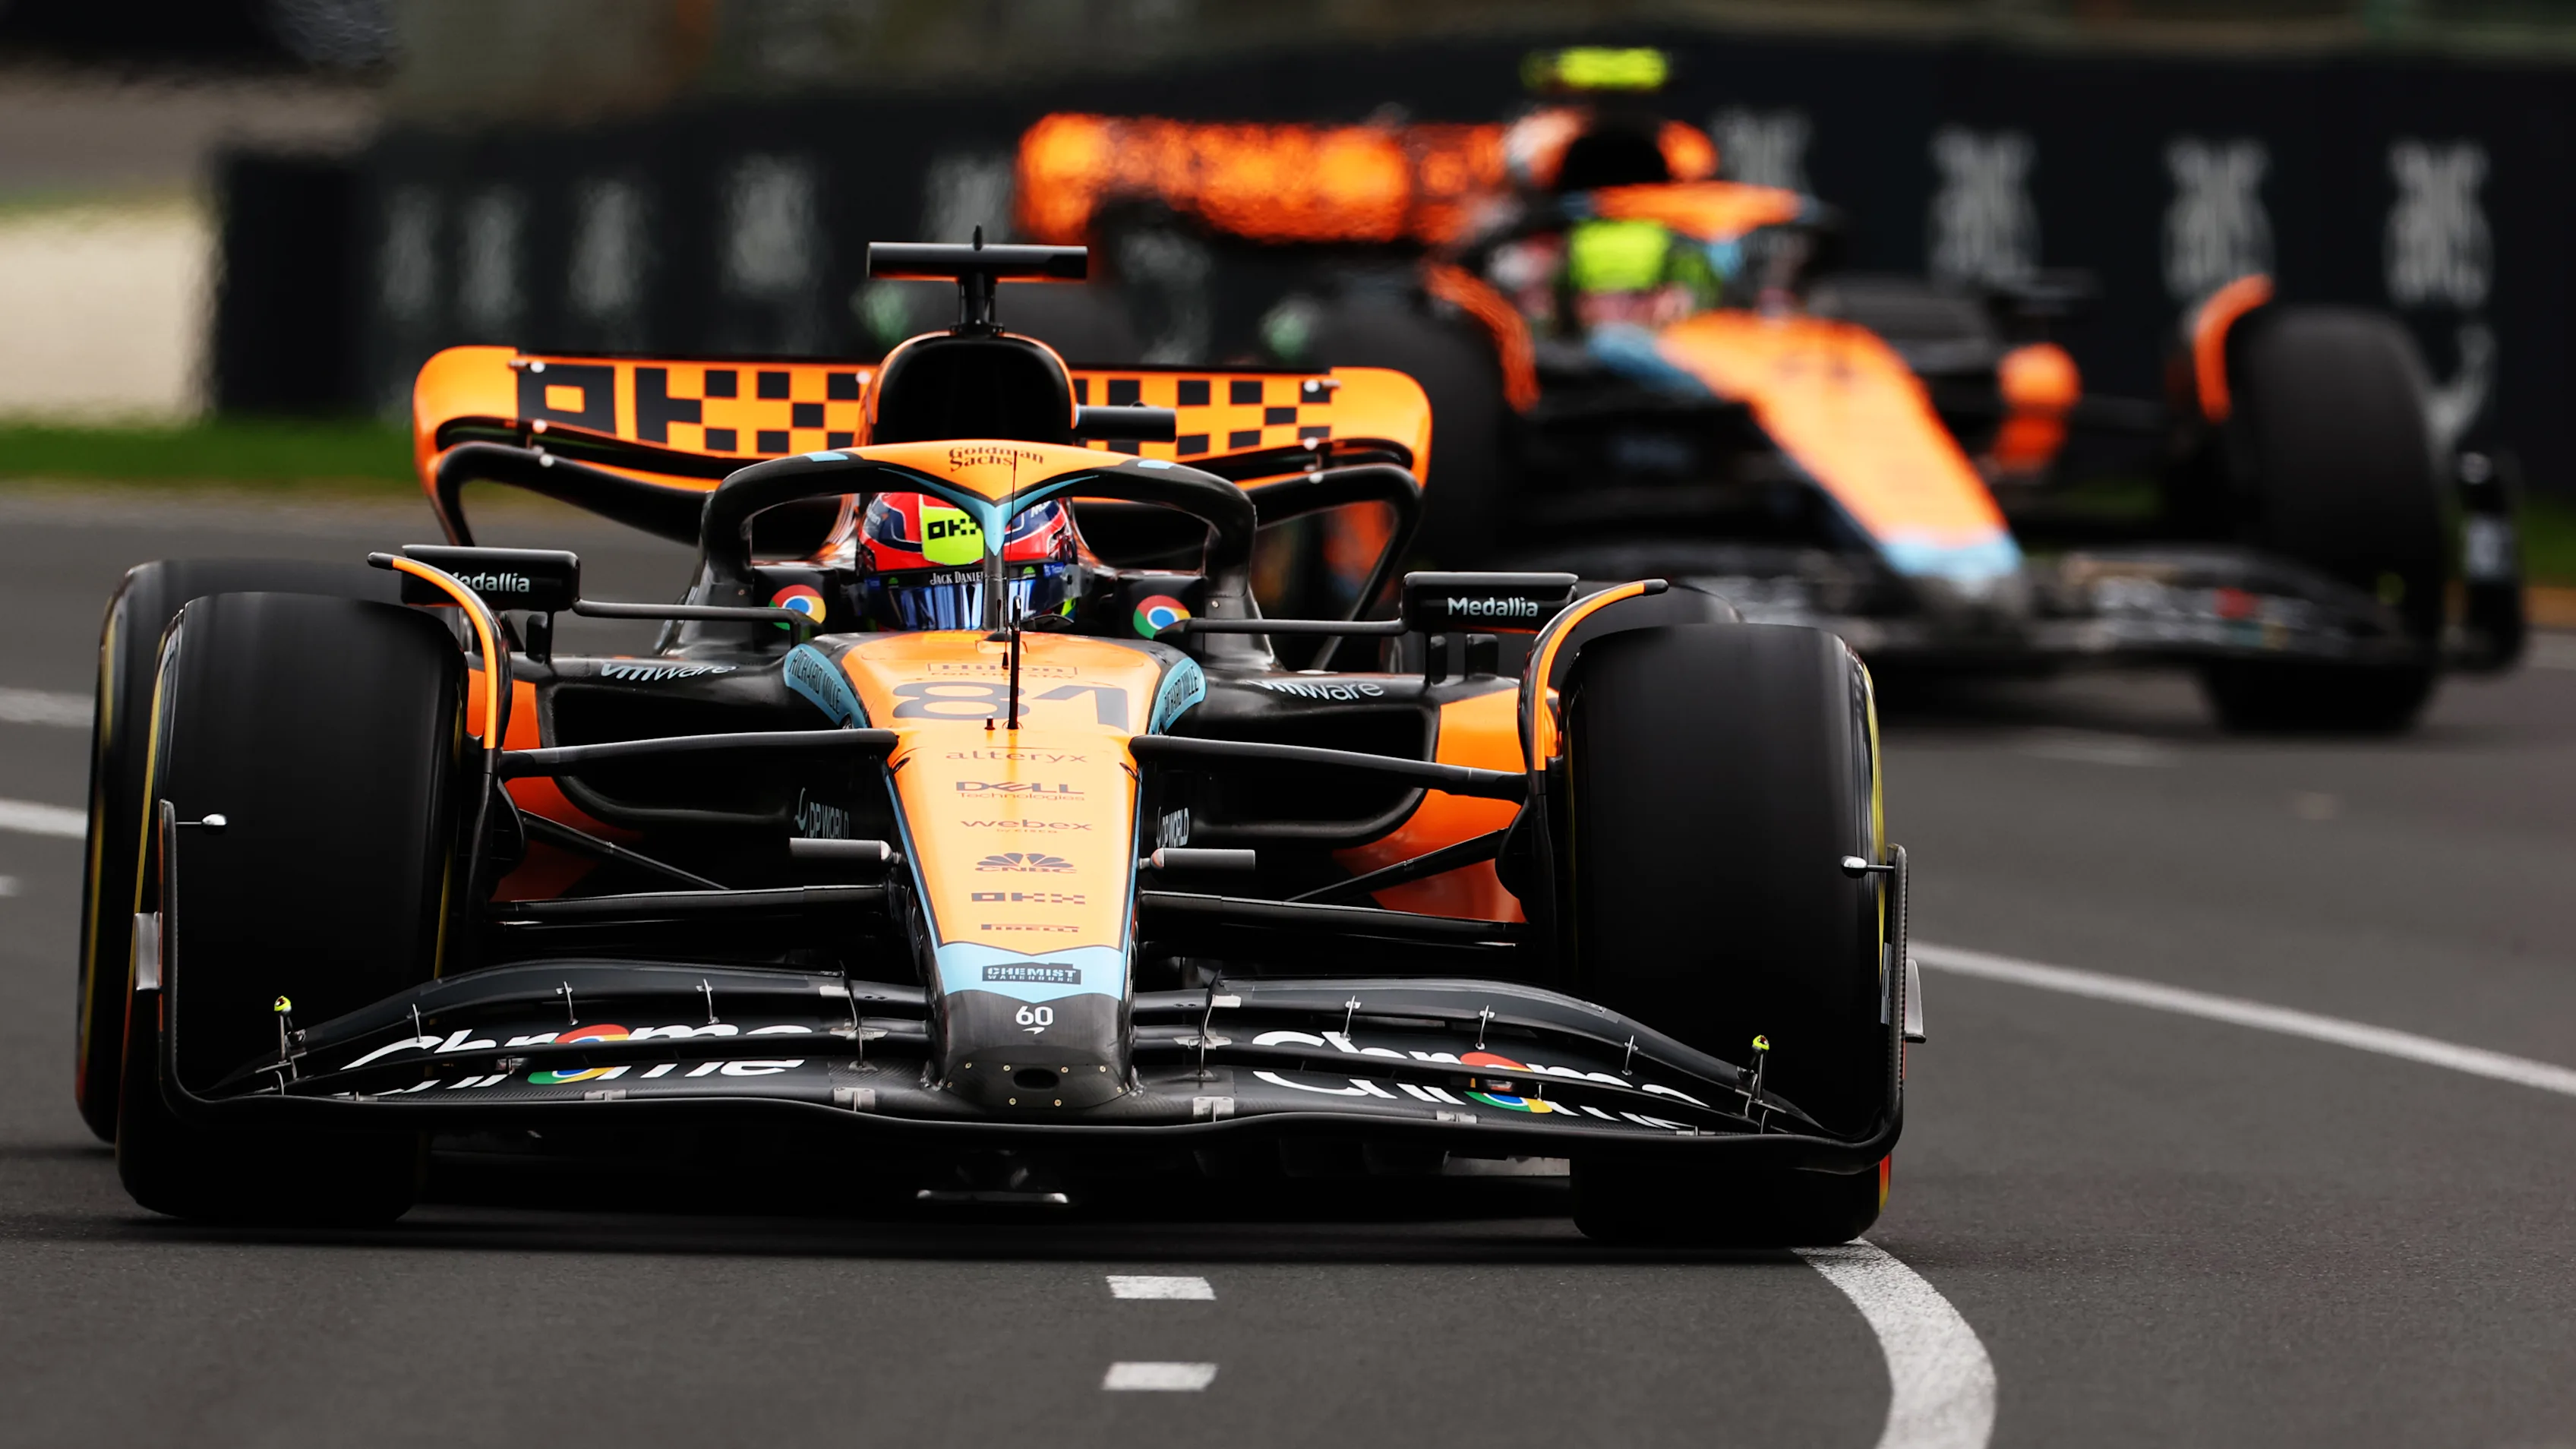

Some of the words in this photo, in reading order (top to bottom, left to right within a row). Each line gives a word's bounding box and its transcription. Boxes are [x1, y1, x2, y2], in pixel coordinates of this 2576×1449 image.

[1072, 377, 1331, 456] KX
[949, 447, 1043, 466] Goldman
[949, 455, 1013, 472] Sachs
[453, 572, 530, 592] edallia
[1447, 596, 1539, 617] Medallia
[601, 663, 737, 681] vmware
[1246, 680, 1384, 700] vmware
[892, 681, 1129, 734] 81
[945, 750, 1089, 764] alteryx
[955, 781, 1084, 794] DELL
[960, 793, 1085, 801] Technologies
[961, 819, 1093, 831] webex
[987, 967, 1077, 977] CHEMIST
[1015, 1005, 1054, 1026] 60
